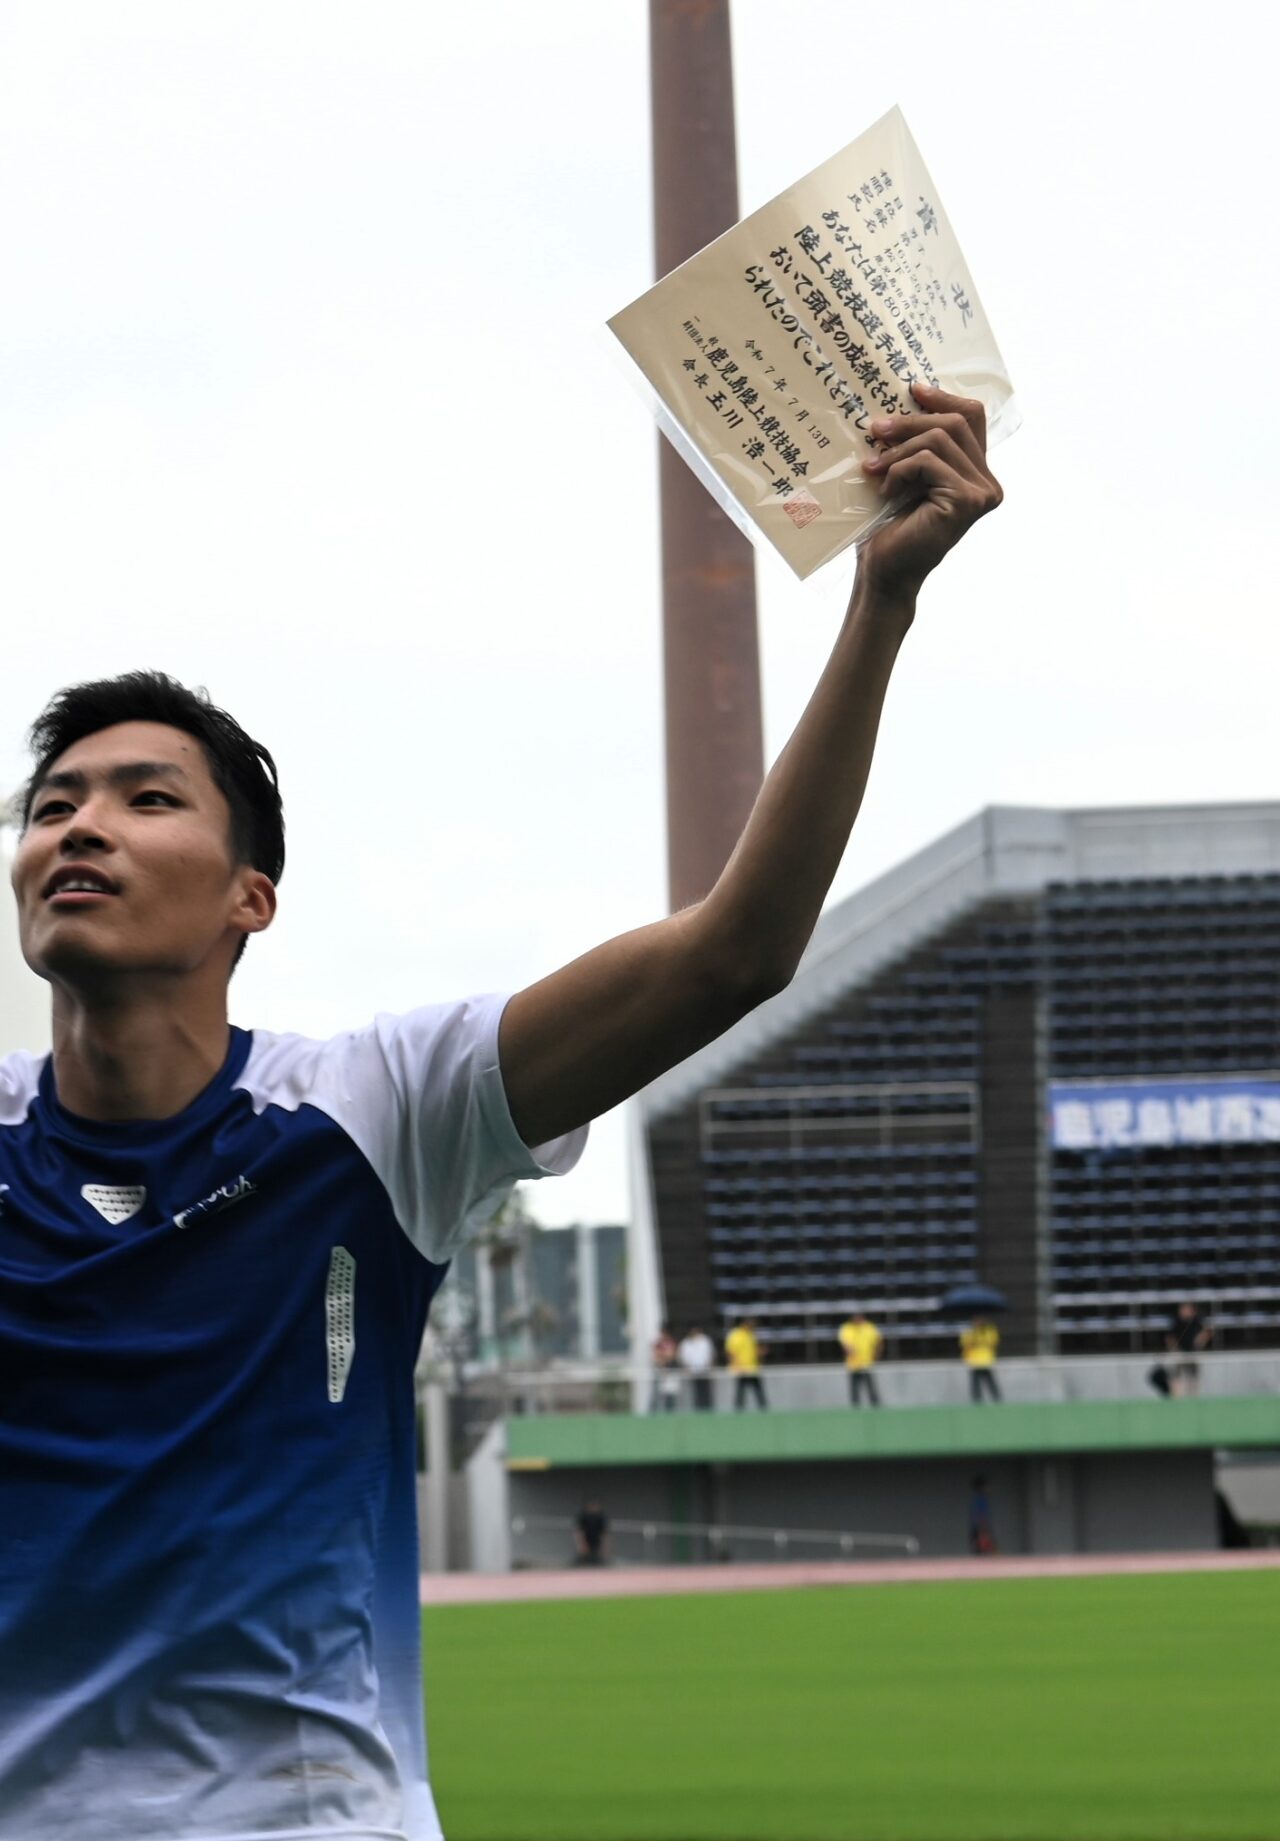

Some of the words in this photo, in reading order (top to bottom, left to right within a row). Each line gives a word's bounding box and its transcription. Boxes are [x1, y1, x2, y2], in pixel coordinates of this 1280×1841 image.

[703, 345, 810, 478] 鹿児島陸上競技協会
